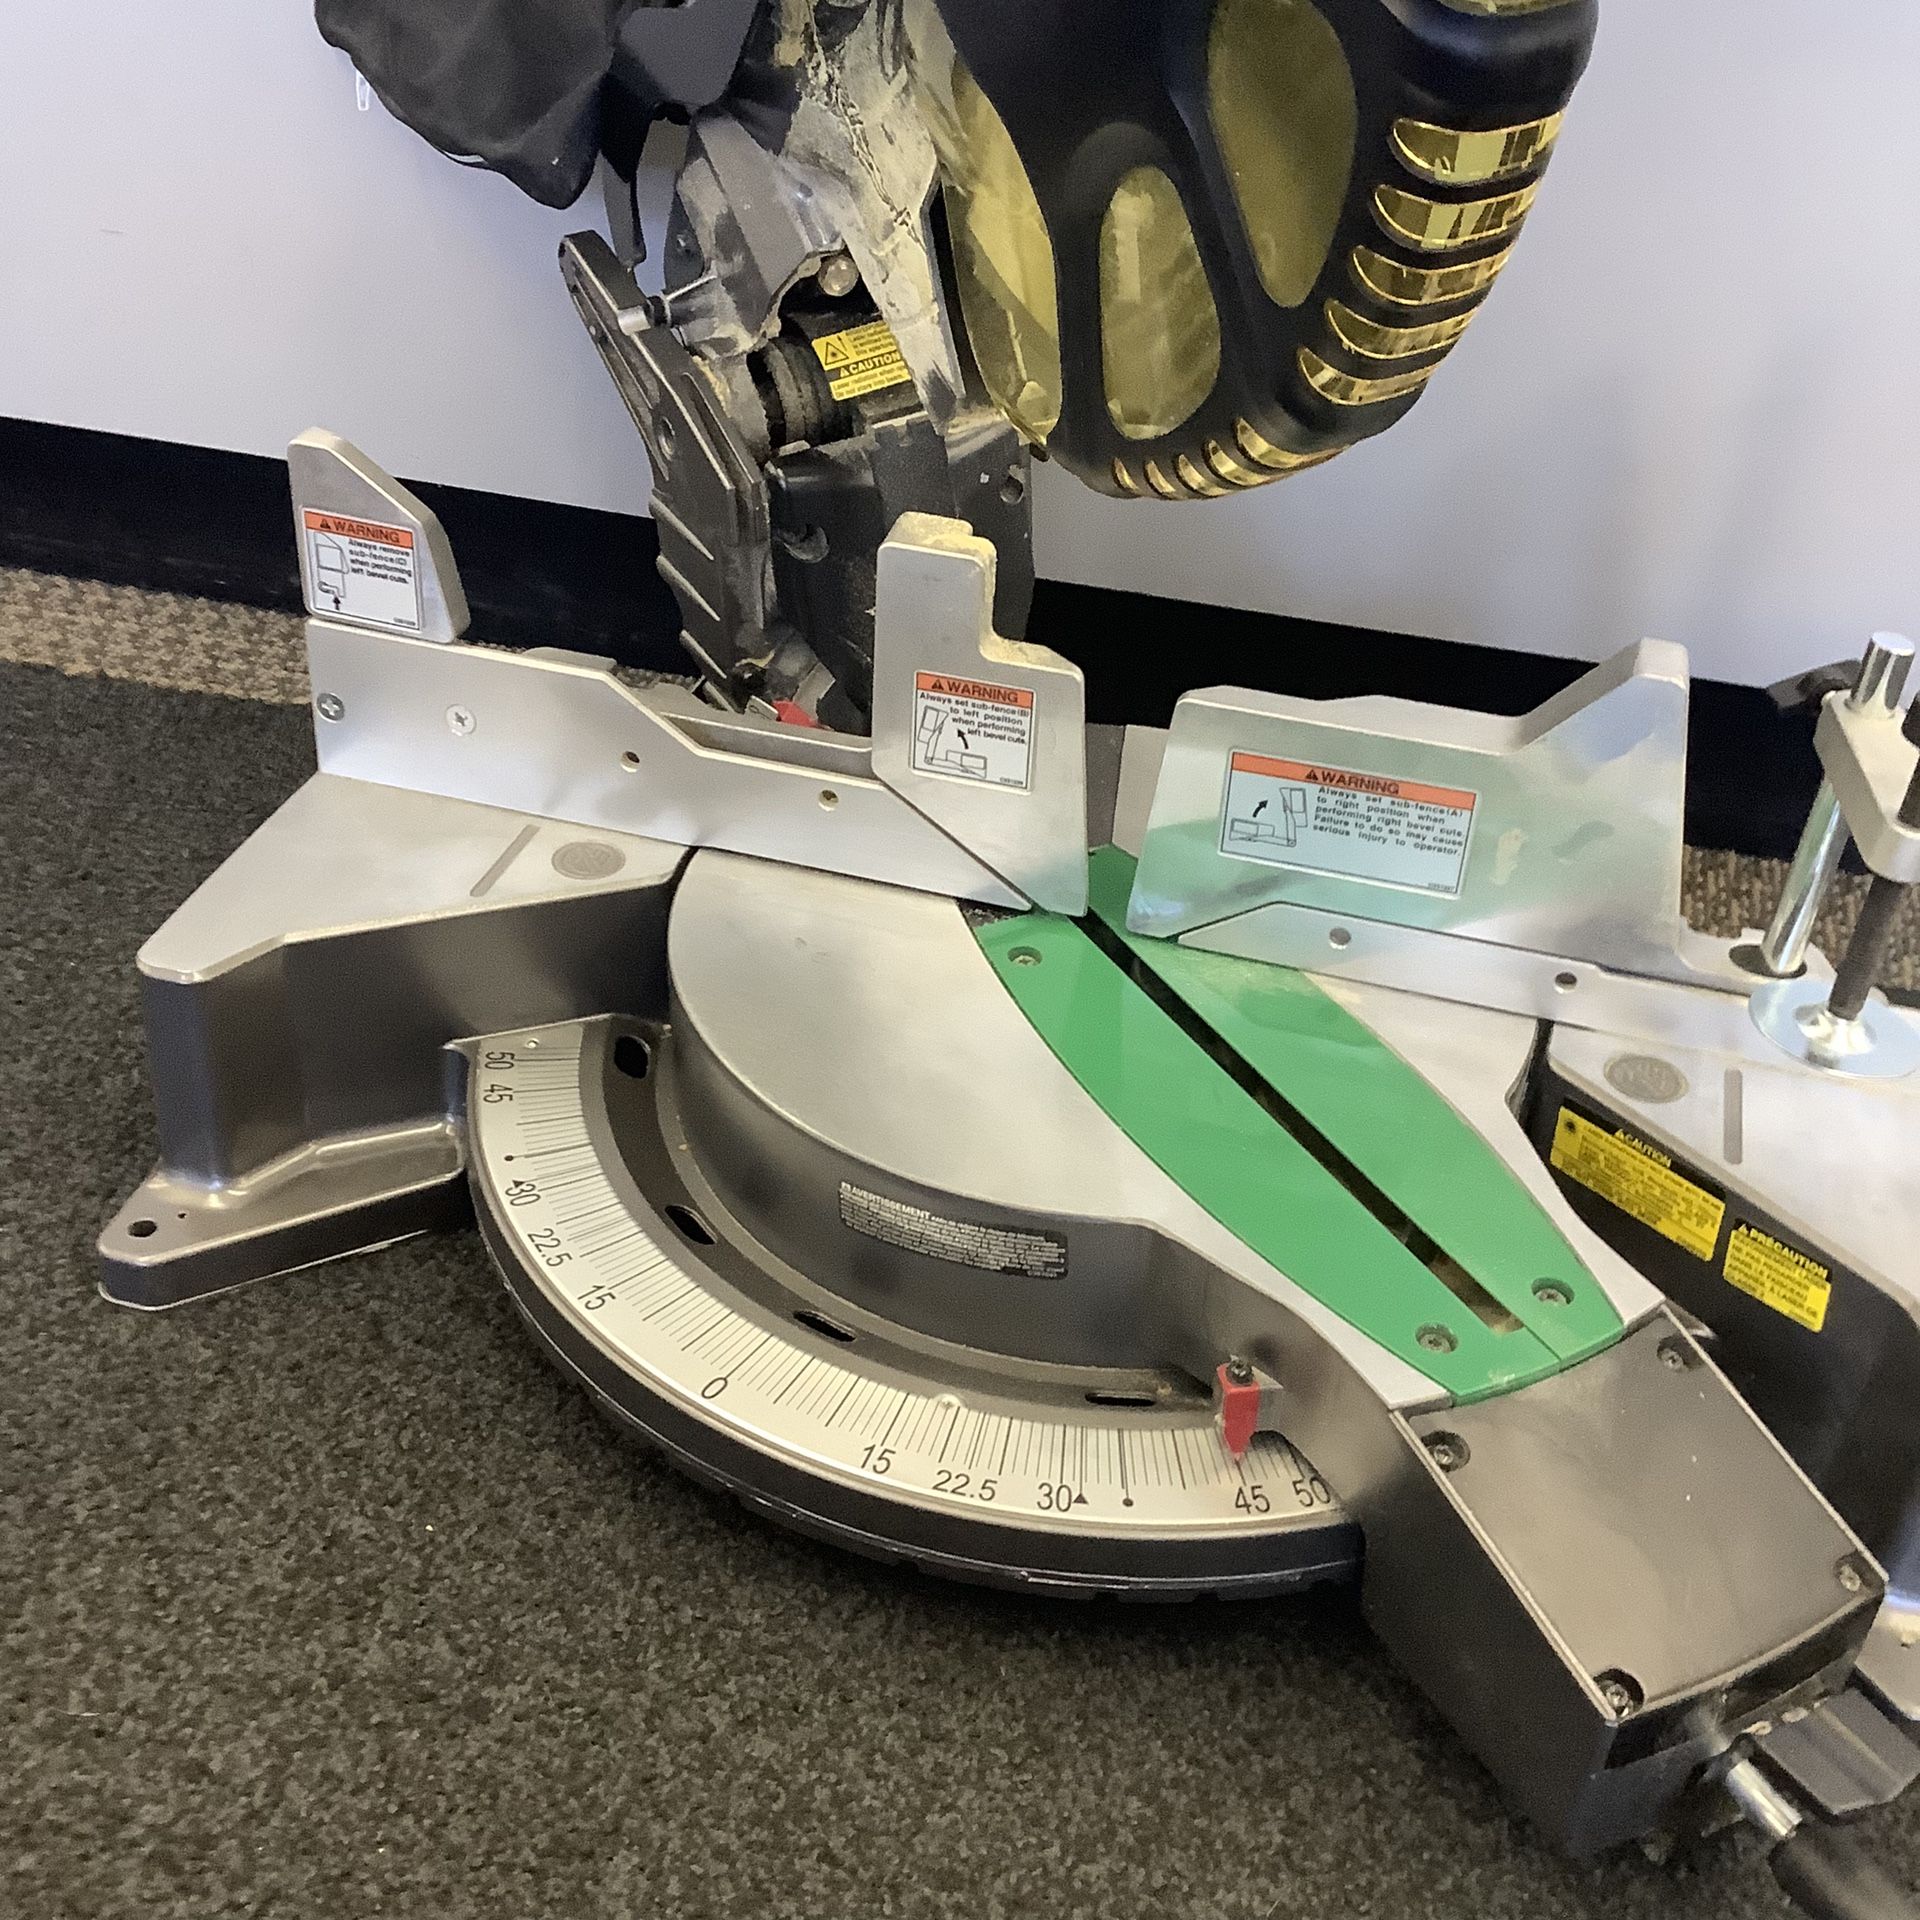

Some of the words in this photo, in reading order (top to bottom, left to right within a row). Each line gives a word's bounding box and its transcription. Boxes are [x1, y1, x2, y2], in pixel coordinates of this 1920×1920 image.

[849, 352, 901, 374] CAUTION
[334, 521, 400, 543] WARNING
[348, 538, 377, 551] Always
[379, 546, 410, 557] remove
[350, 558, 370, 566] when
[372, 561, 412, 578] performing
[920, 692, 952, 705] Always
[947, 680, 1018, 703] WARNING
[950, 706, 960, 714] to
[964, 708, 979, 718] left
[984, 713, 1023, 726] position
[952, 716, 976, 726] when
[978, 721, 1026, 737] performing
[968, 728, 981, 736] left
[983, 731, 1006, 742] bevel
[1322, 770, 1400, 794] WARNING
[1318, 786, 1357, 800] Always
[1366, 796, 1382, 804] set
[1316, 806, 1372, 822] performing
[1378, 816, 1402, 826] right
[1406, 821, 1435, 832] bevel
[1335, 800, 1359, 810] right
[1367, 805, 1410, 818] position
[1418, 814, 1446, 824] when
[1313, 824, 1350, 836] serious
[1358, 832, 1388, 844] injury
[1396, 838, 1406, 846] to
[1314, 814, 1350, 826] Failure
[1370, 824, 1383, 832] do
[1388, 828, 1400, 836] so
[1406, 830, 1427, 842] may
[1432, 836, 1464, 847] cause
[484, 1050, 516, 1070] 50
[483, 1083, 513, 1104] 45
[1626, 1134, 1672, 1168] CAUTION
[505, 1181, 541, 1207] 30
[527, 1227, 573, 1268] 22.5
[578, 1284, 616, 1311] 15
[700, 1376, 728, 1400] 0
[861, 1444, 896, 1474] 15
[932, 1469, 998, 1502] 22.5
[1036, 1482, 1072, 1512] 30
[1292, 1475, 1331, 1508] 50
[1234, 1484, 1270, 1514] 45
